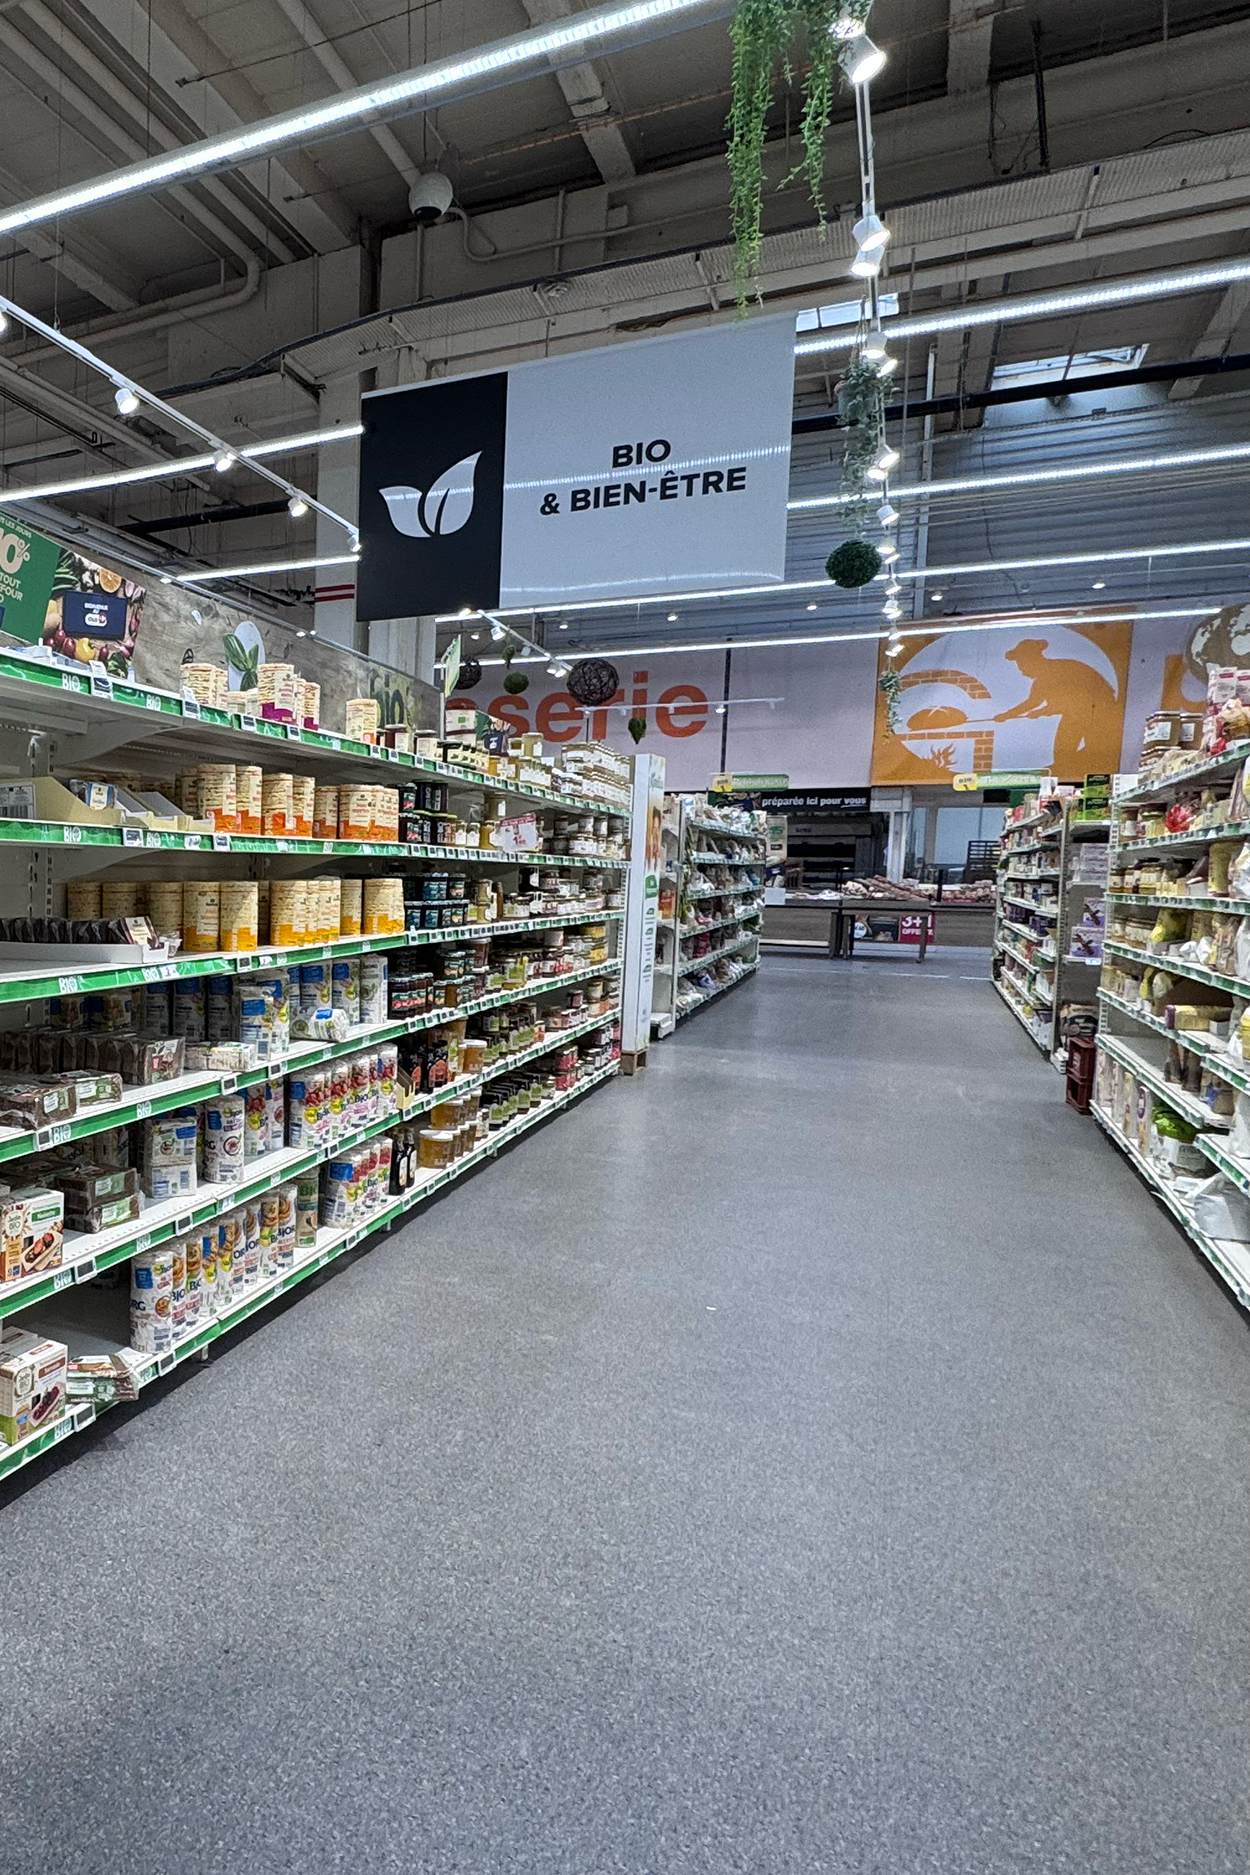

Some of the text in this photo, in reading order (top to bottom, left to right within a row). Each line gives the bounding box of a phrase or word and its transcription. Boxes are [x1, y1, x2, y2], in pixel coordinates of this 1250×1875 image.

[612, 439, 671, 469] BIO
[540, 467, 747, 515] & BIEN-ÊTRE
[0, 573, 21, 588] TOUT
[762, 797, 866, 808] préparée ici pour vous
[64, 826, 81, 843] BIO
[52, 1124, 71, 1144] BIO
